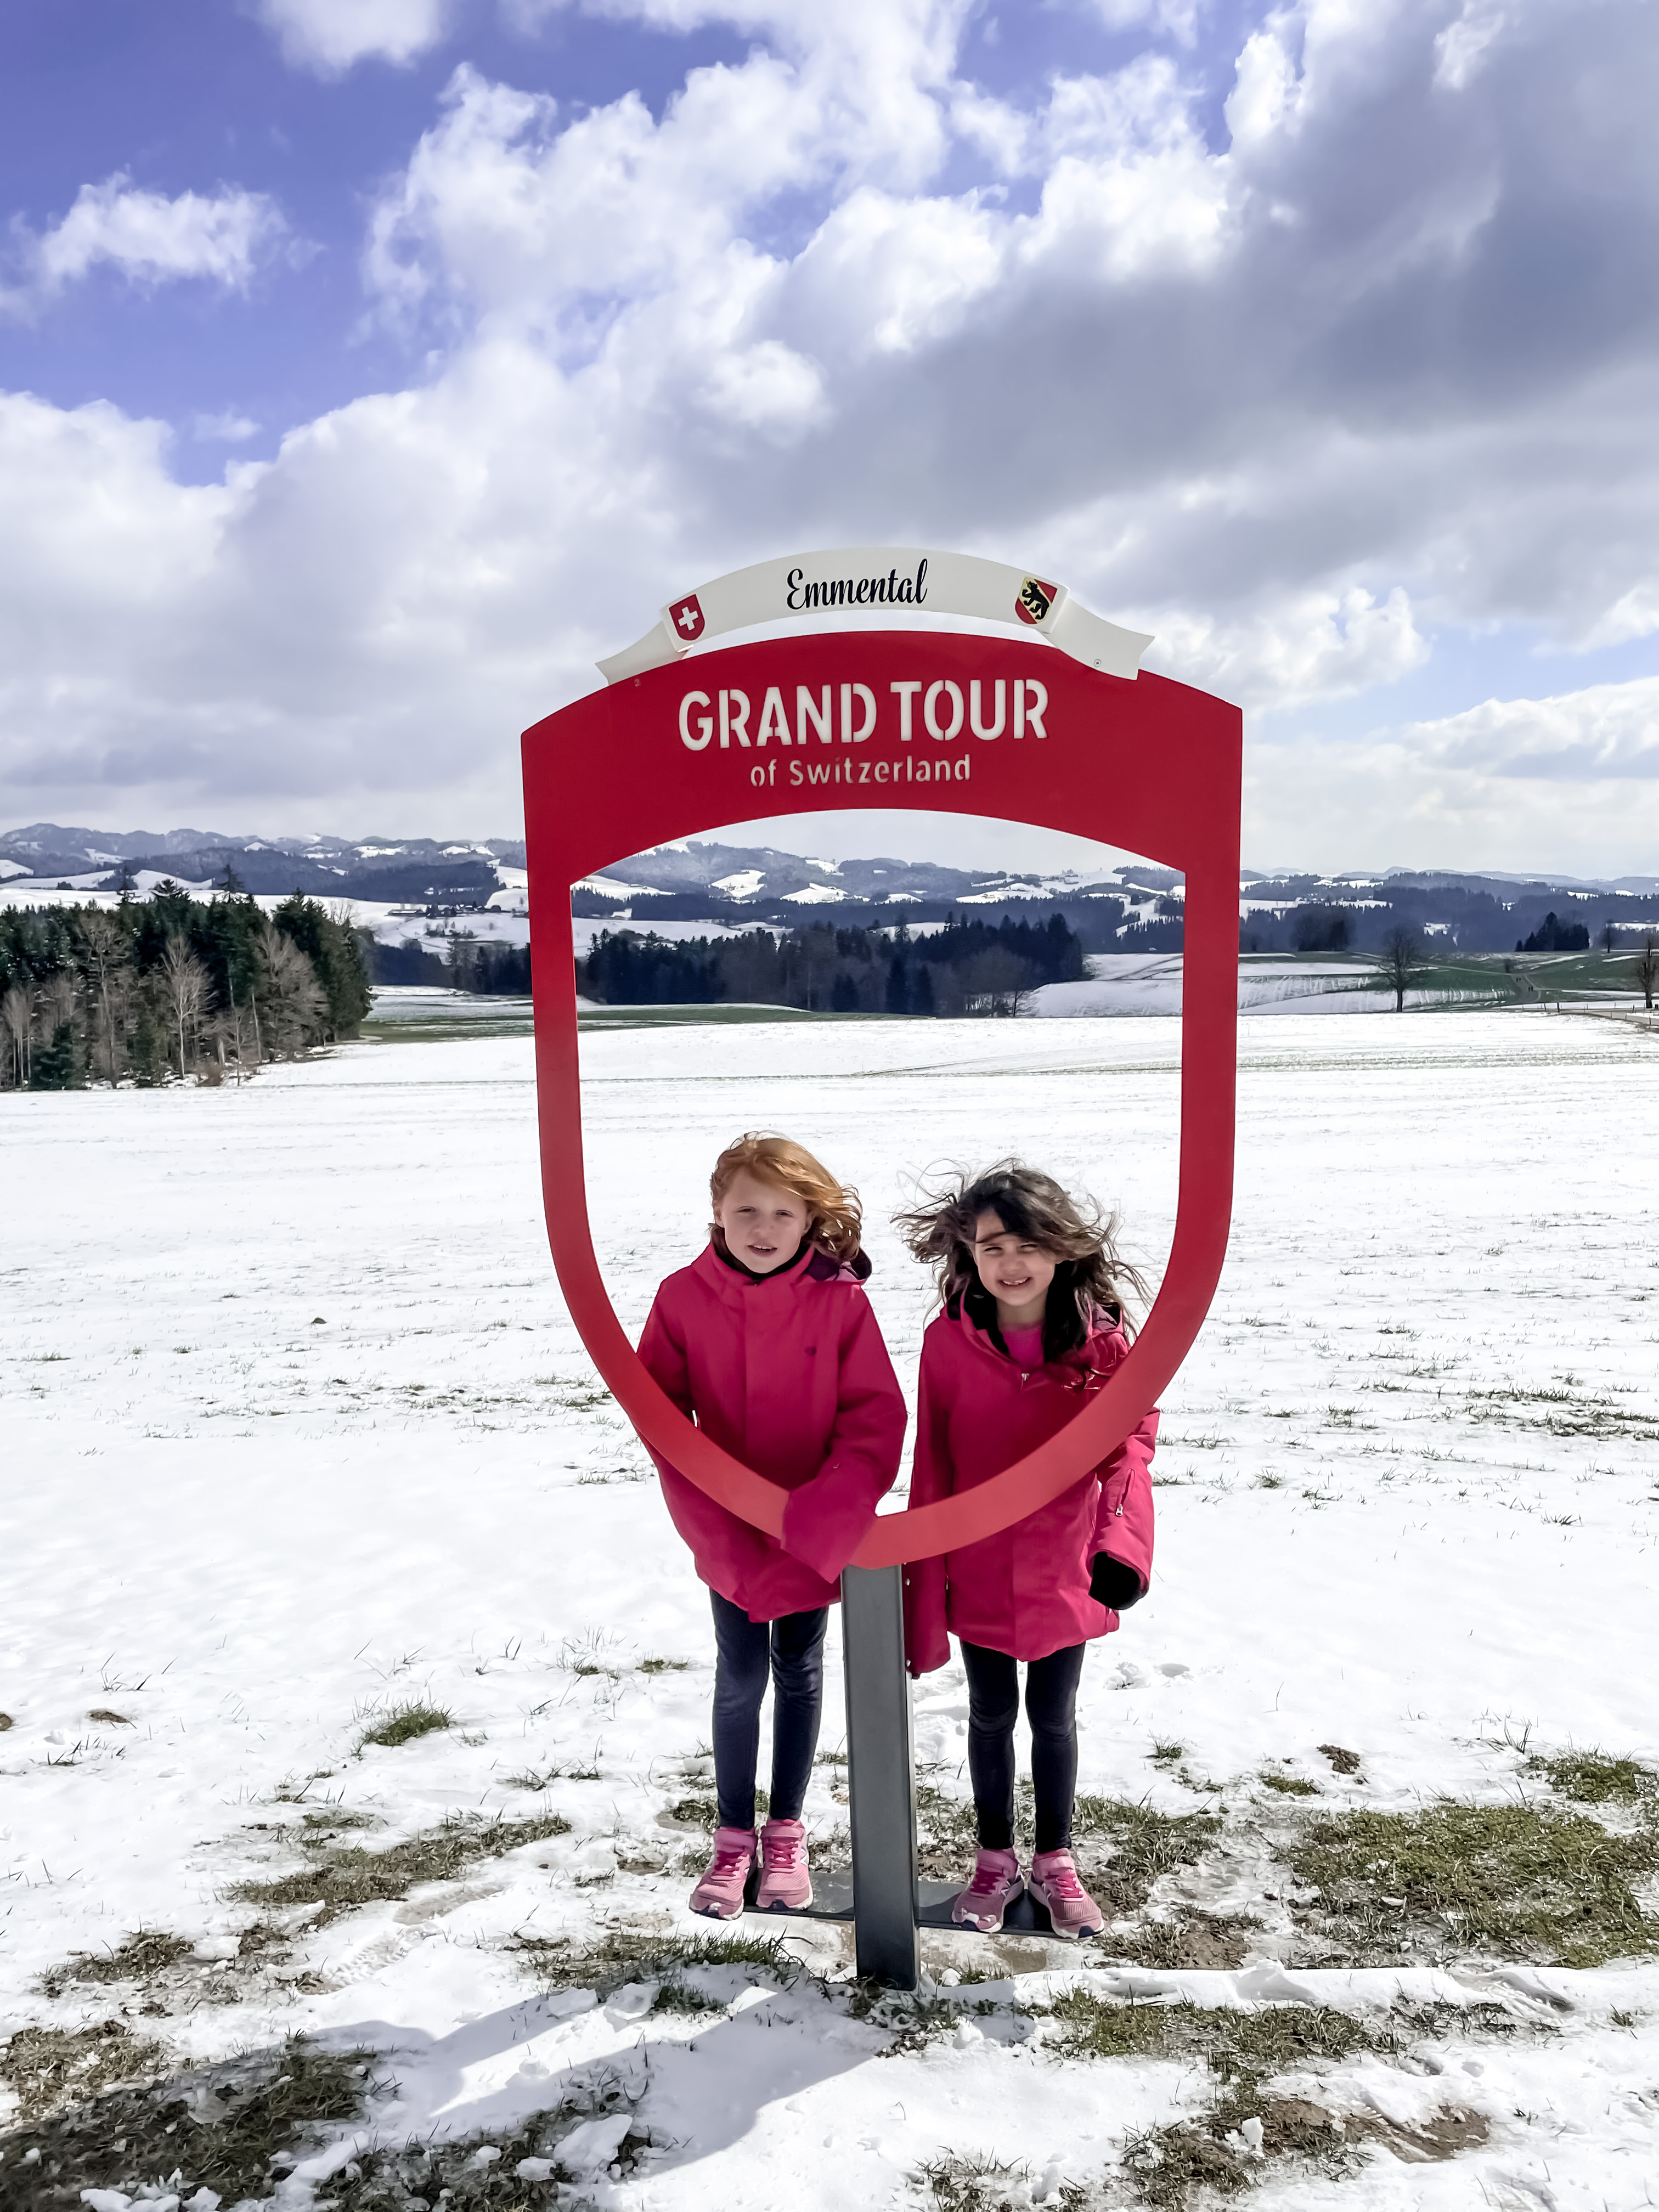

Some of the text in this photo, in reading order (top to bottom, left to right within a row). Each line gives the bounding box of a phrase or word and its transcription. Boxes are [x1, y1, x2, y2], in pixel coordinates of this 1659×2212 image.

[787, 558, 928, 610] Emmental
[679, 679, 1048, 751] GRAND TOUR
[751, 754, 970, 787] of Switzerland
